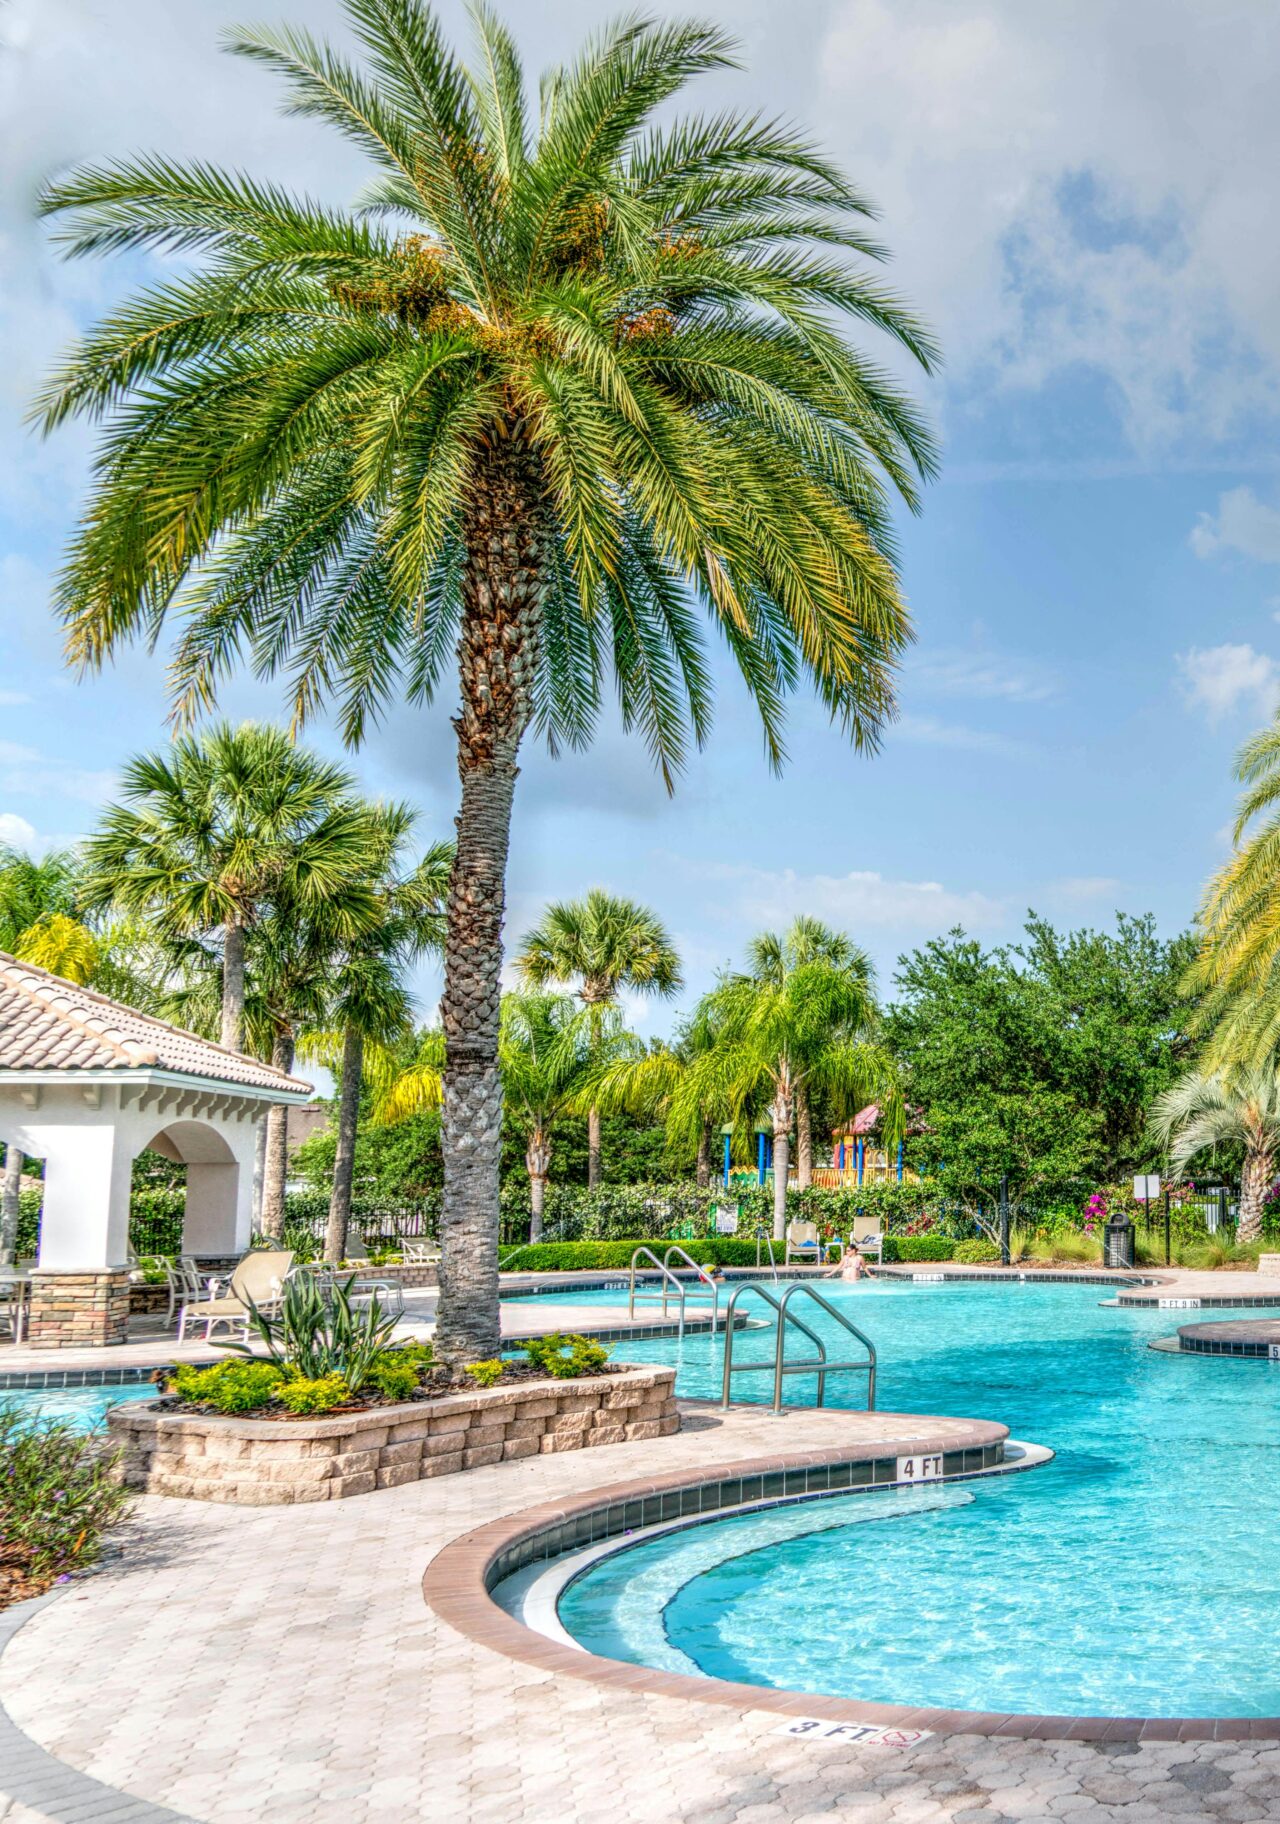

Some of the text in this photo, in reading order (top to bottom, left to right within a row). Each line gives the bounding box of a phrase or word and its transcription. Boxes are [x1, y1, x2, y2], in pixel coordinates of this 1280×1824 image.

[1272, 1346, 1279, 1358] 5
[904, 1456, 941, 1478] 4 FT.
[789, 1721, 879, 1741] 3 FT.
